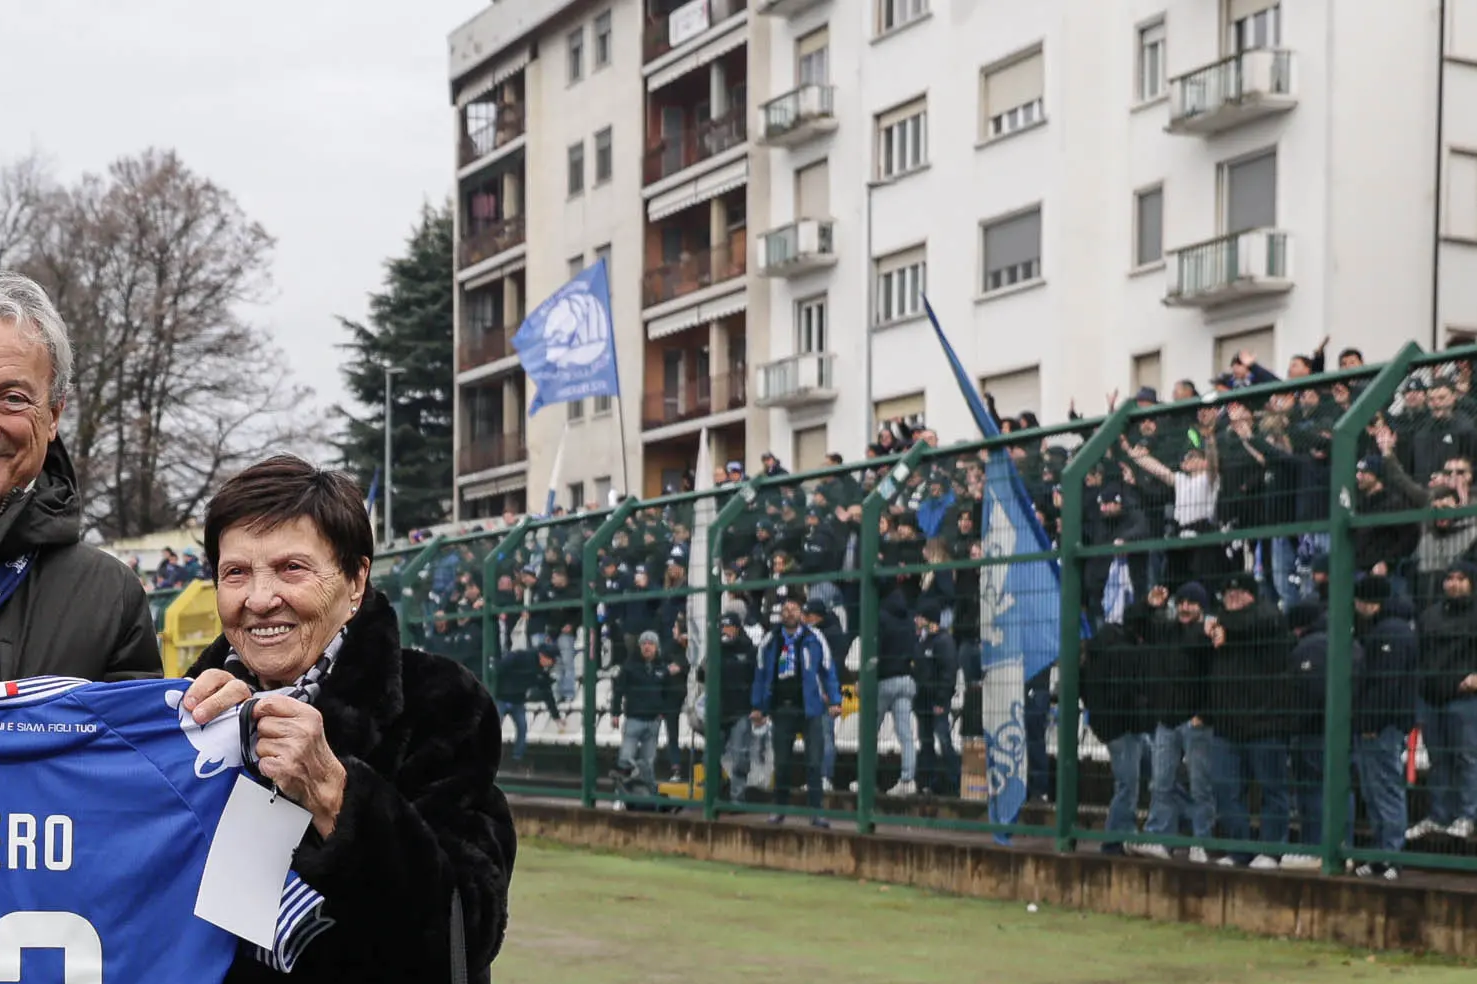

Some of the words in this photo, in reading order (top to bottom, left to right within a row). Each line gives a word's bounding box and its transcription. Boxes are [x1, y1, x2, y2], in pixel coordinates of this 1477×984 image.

[7, 722, 14, 731] E
[16, 722, 45, 732] SIAM
[47, 723, 72, 732] FIGLI
[75, 723, 97, 733] TUOI
